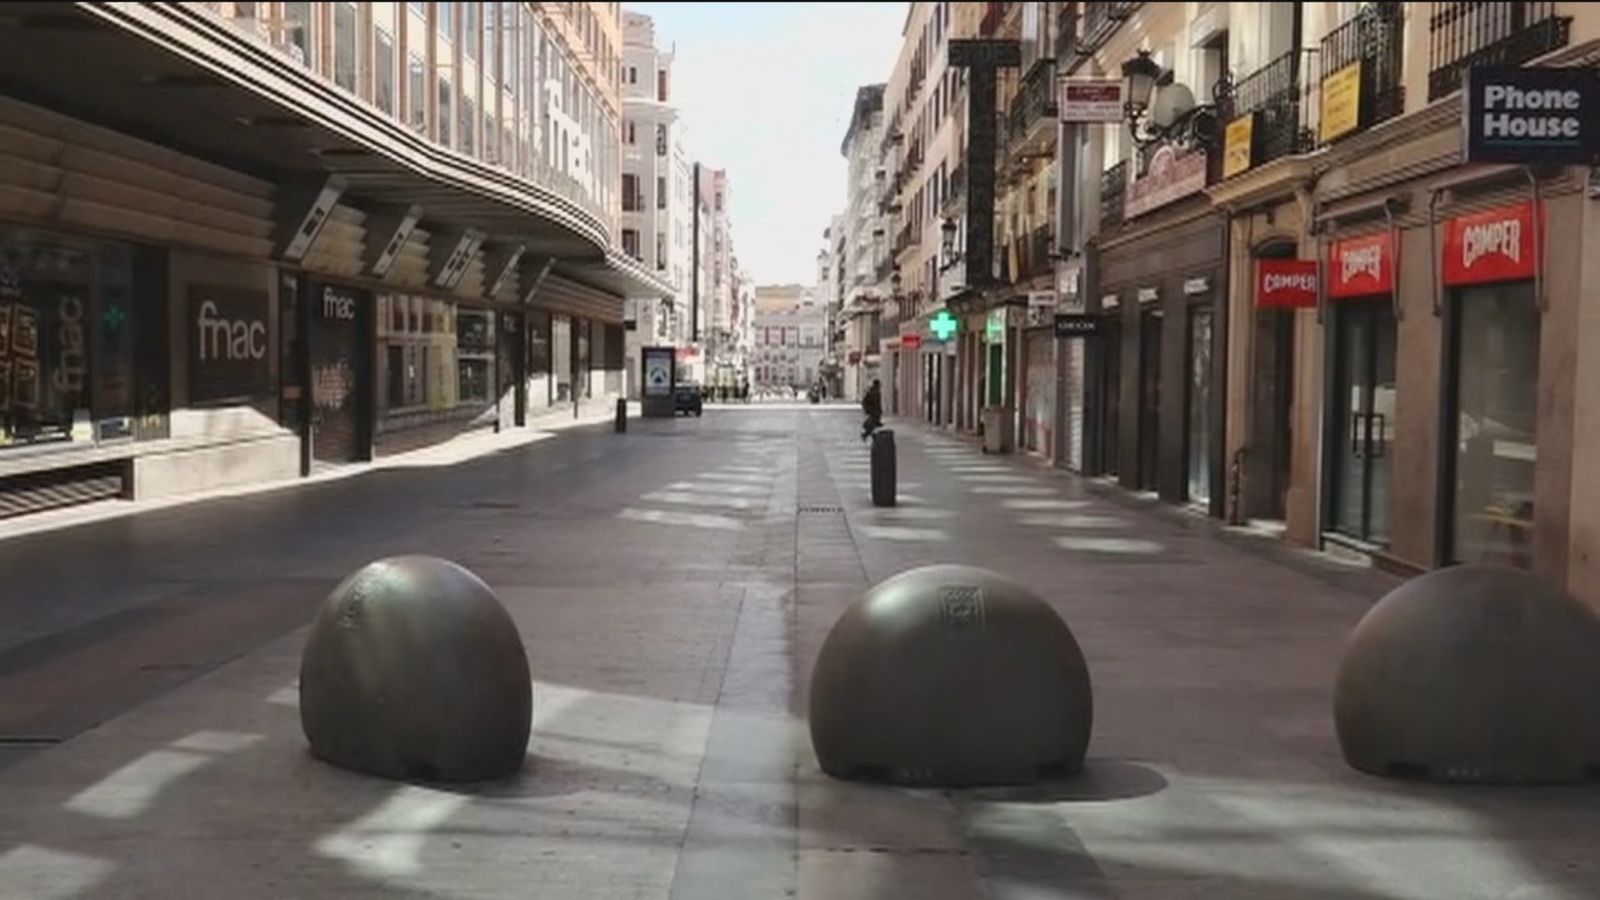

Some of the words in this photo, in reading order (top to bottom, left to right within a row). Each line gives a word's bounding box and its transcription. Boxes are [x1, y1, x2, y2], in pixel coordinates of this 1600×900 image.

[1484, 85, 1580, 109] Phone
[544, 79, 593, 199] fnac
[1484, 113, 1580, 137] House
[1463, 219, 1520, 268] CAMPER
[1264, 273, 1316, 293] CAMPER
[1341, 245, 1380, 284] CAMPER
[324, 286, 355, 320] fnac
[53, 296, 85, 391] fnac
[198, 299, 266, 360] fnac
